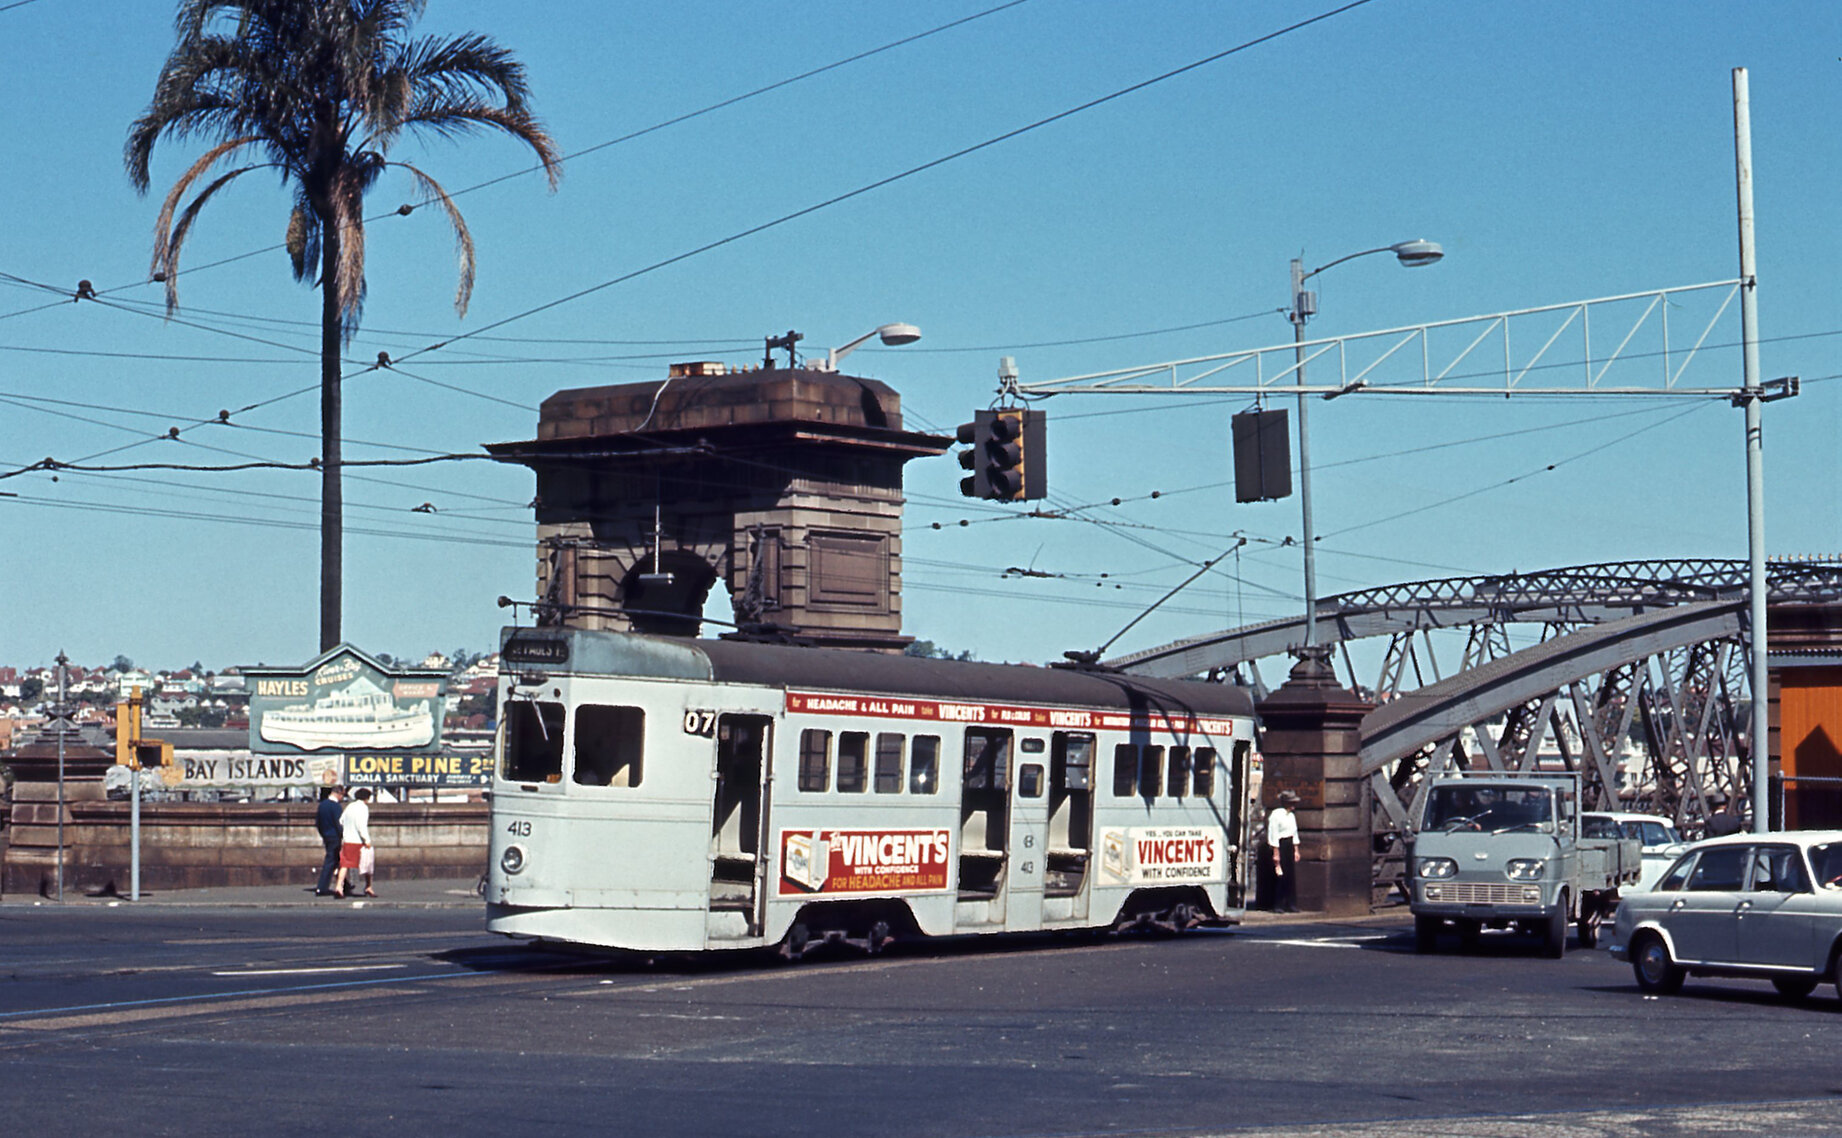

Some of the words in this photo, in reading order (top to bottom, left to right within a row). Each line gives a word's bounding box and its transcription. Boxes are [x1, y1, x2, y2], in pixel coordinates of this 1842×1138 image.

[315, 672, 354, 686] CRUISES
[257, 681, 308, 696] HAYLES
[806, 698, 857, 711] HEADACHE
[869, 702, 889, 713] ALL
[891, 703, 915, 715] PAIN
[685, 711, 716, 733] 07
[184, 758, 217, 779] BAY
[227, 757, 305, 779] ISLANDS
[349, 757, 403, 773] LONE
[411, 757, 462, 774] PINE
[349, 774, 381, 782] KOALA
[385, 774, 440, 783] SANCTUARY
[507, 820, 532, 837] 413
[841, 830, 948, 866] VINCENT'S
[1138, 836, 1214, 865] VINCENT'S
[854, 867, 873, 875] WITH
[874, 865, 919, 874] CONFIDENCE
[1142, 868, 1162, 879] WITH
[1165, 866, 1211, 878] CONFIDENCE
[832, 877, 847, 889] FOR
[848, 874, 901, 889] HEADACHE
[902, 876, 916, 886] AND
[916, 875, 927, 886] ALL
[928, 874, 944, 885] PAIN
